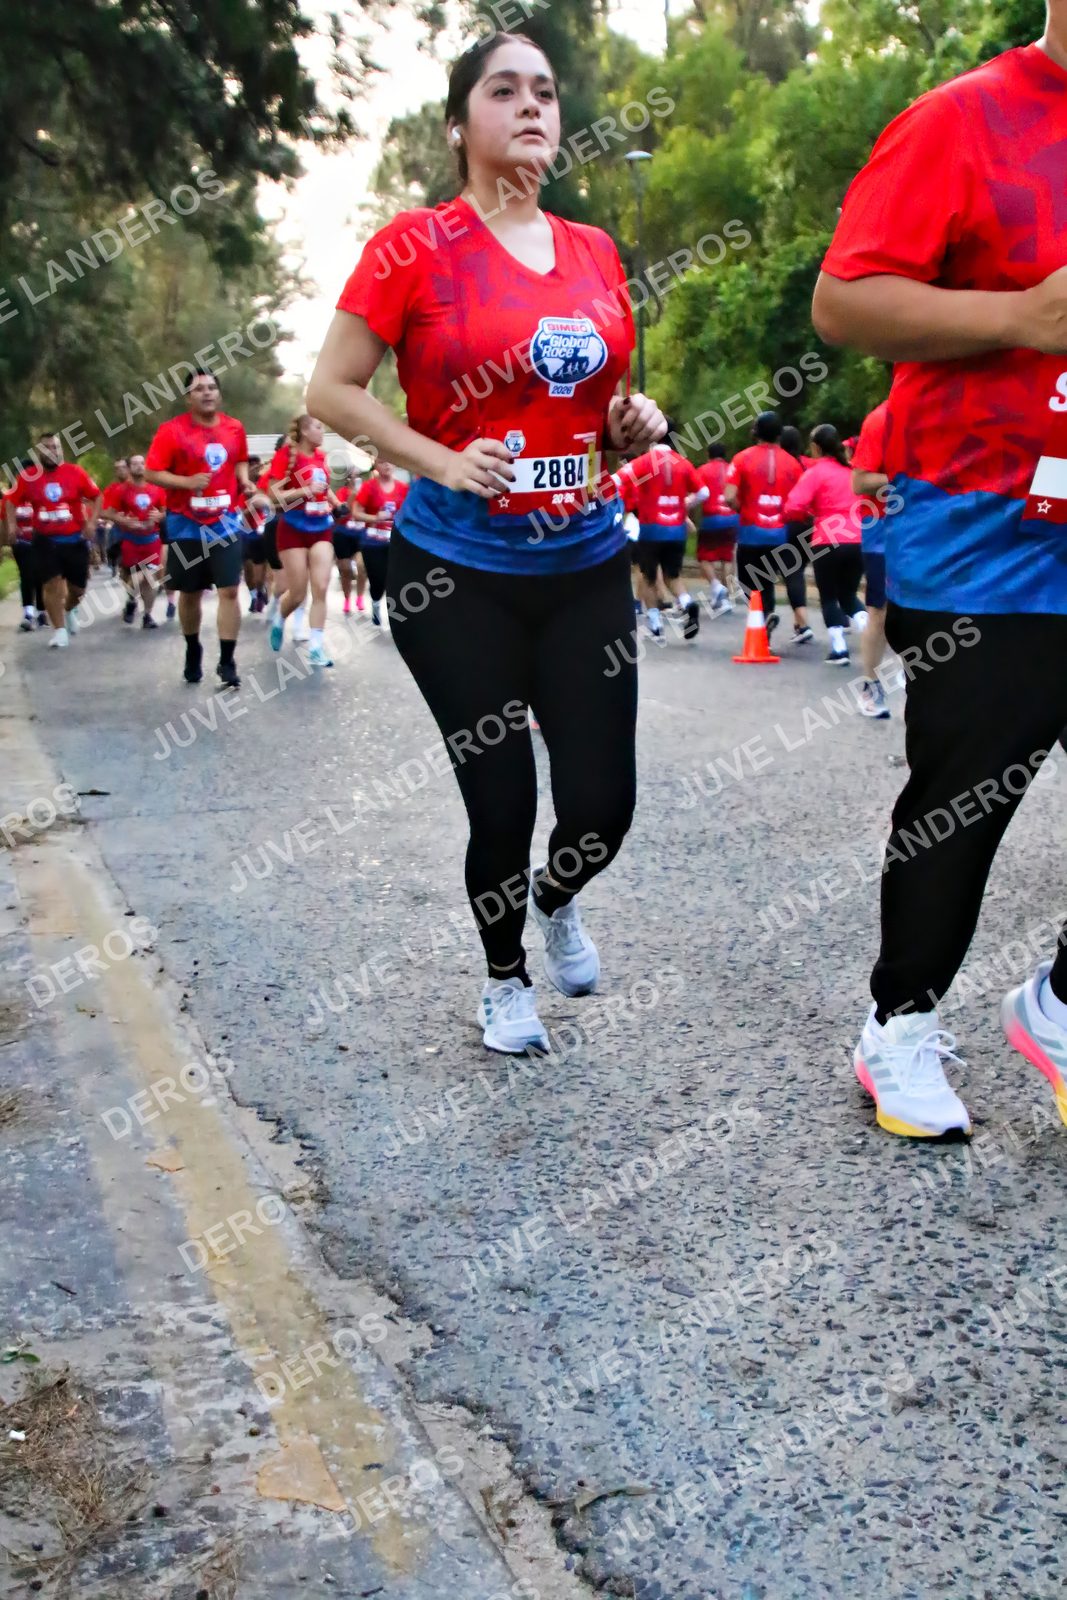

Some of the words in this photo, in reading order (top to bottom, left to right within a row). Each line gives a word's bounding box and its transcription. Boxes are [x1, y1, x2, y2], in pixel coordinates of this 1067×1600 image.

[549, 335, 589, 348] Global
[542, 346, 574, 358] Race
[533, 456, 584, 489] 2884
